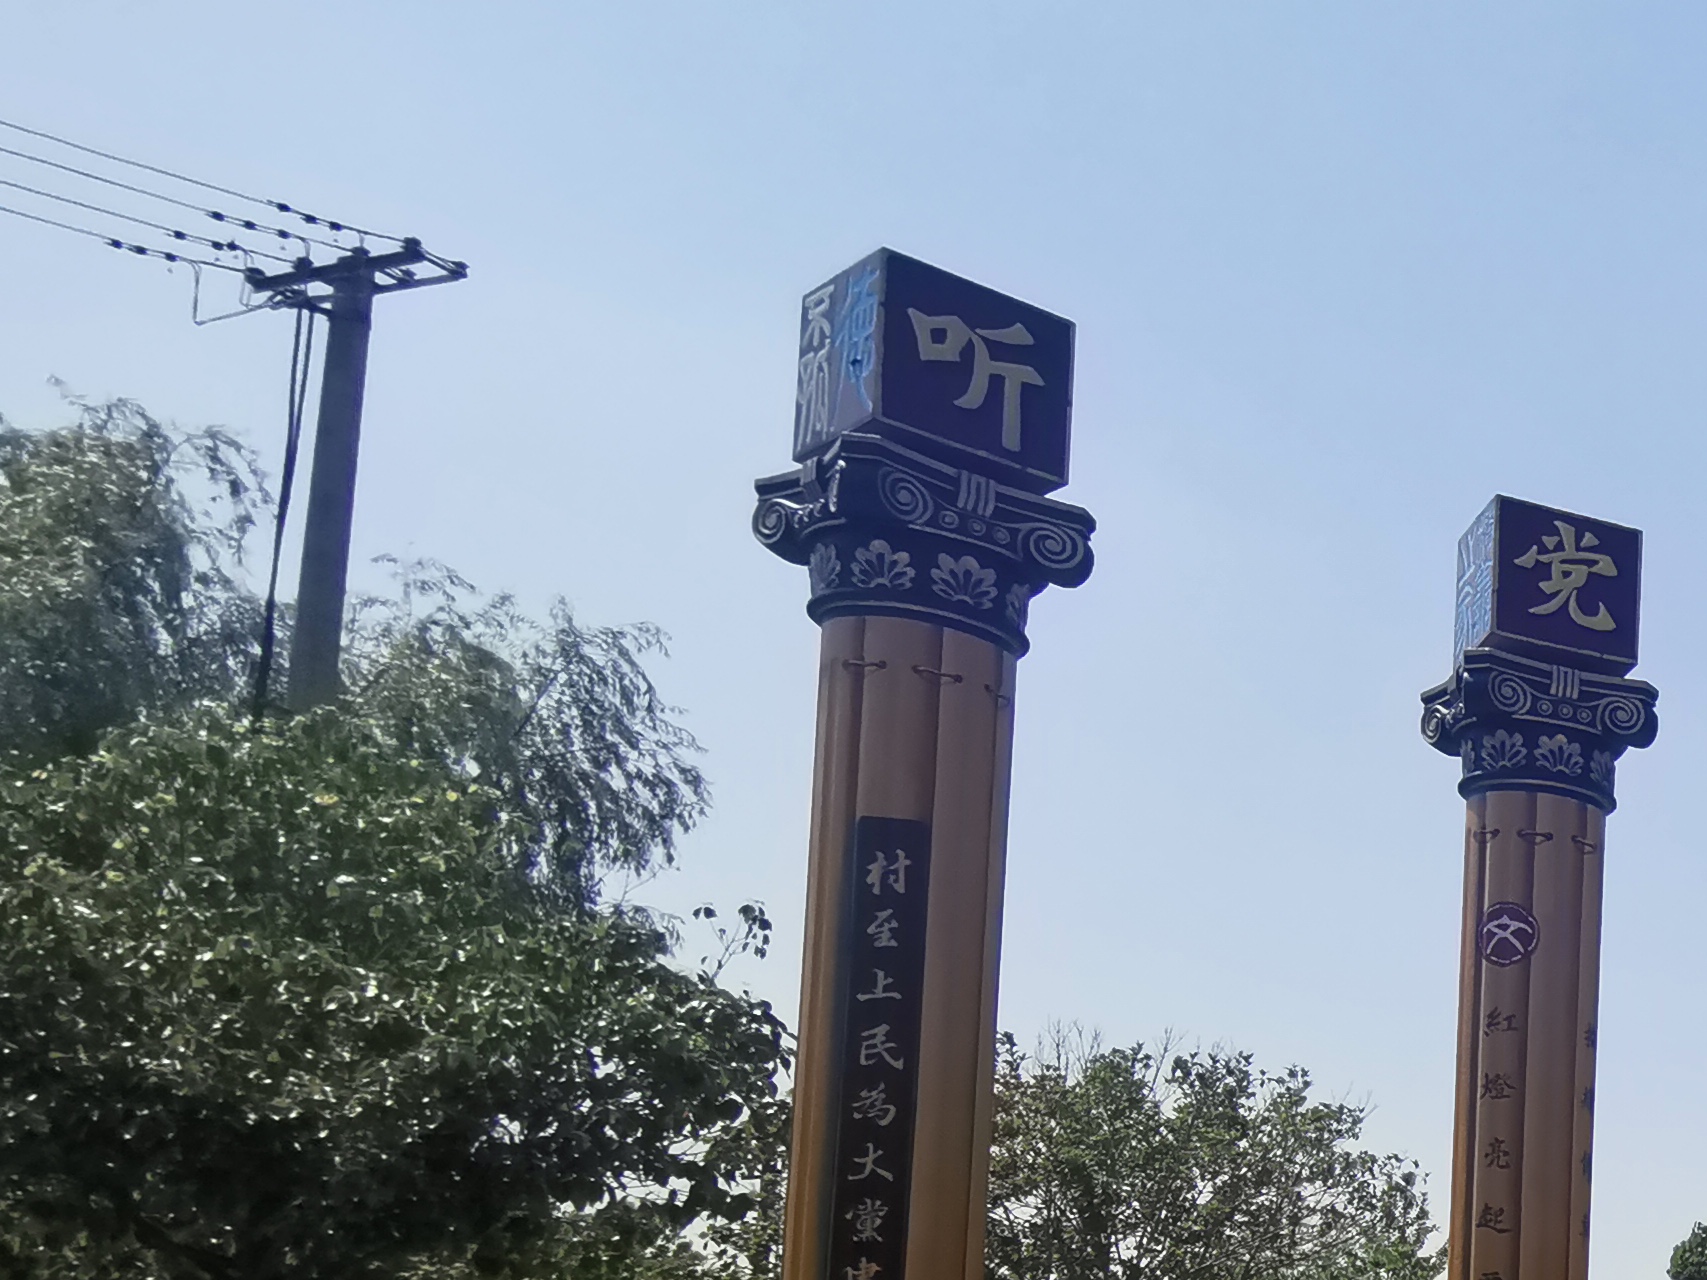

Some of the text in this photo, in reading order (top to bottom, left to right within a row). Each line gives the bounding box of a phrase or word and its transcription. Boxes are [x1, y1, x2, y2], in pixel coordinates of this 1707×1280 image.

[906, 307, 1046, 452] 听
[1513, 519, 1619, 632] 党
[1482, 914, 1534, 955] 文
